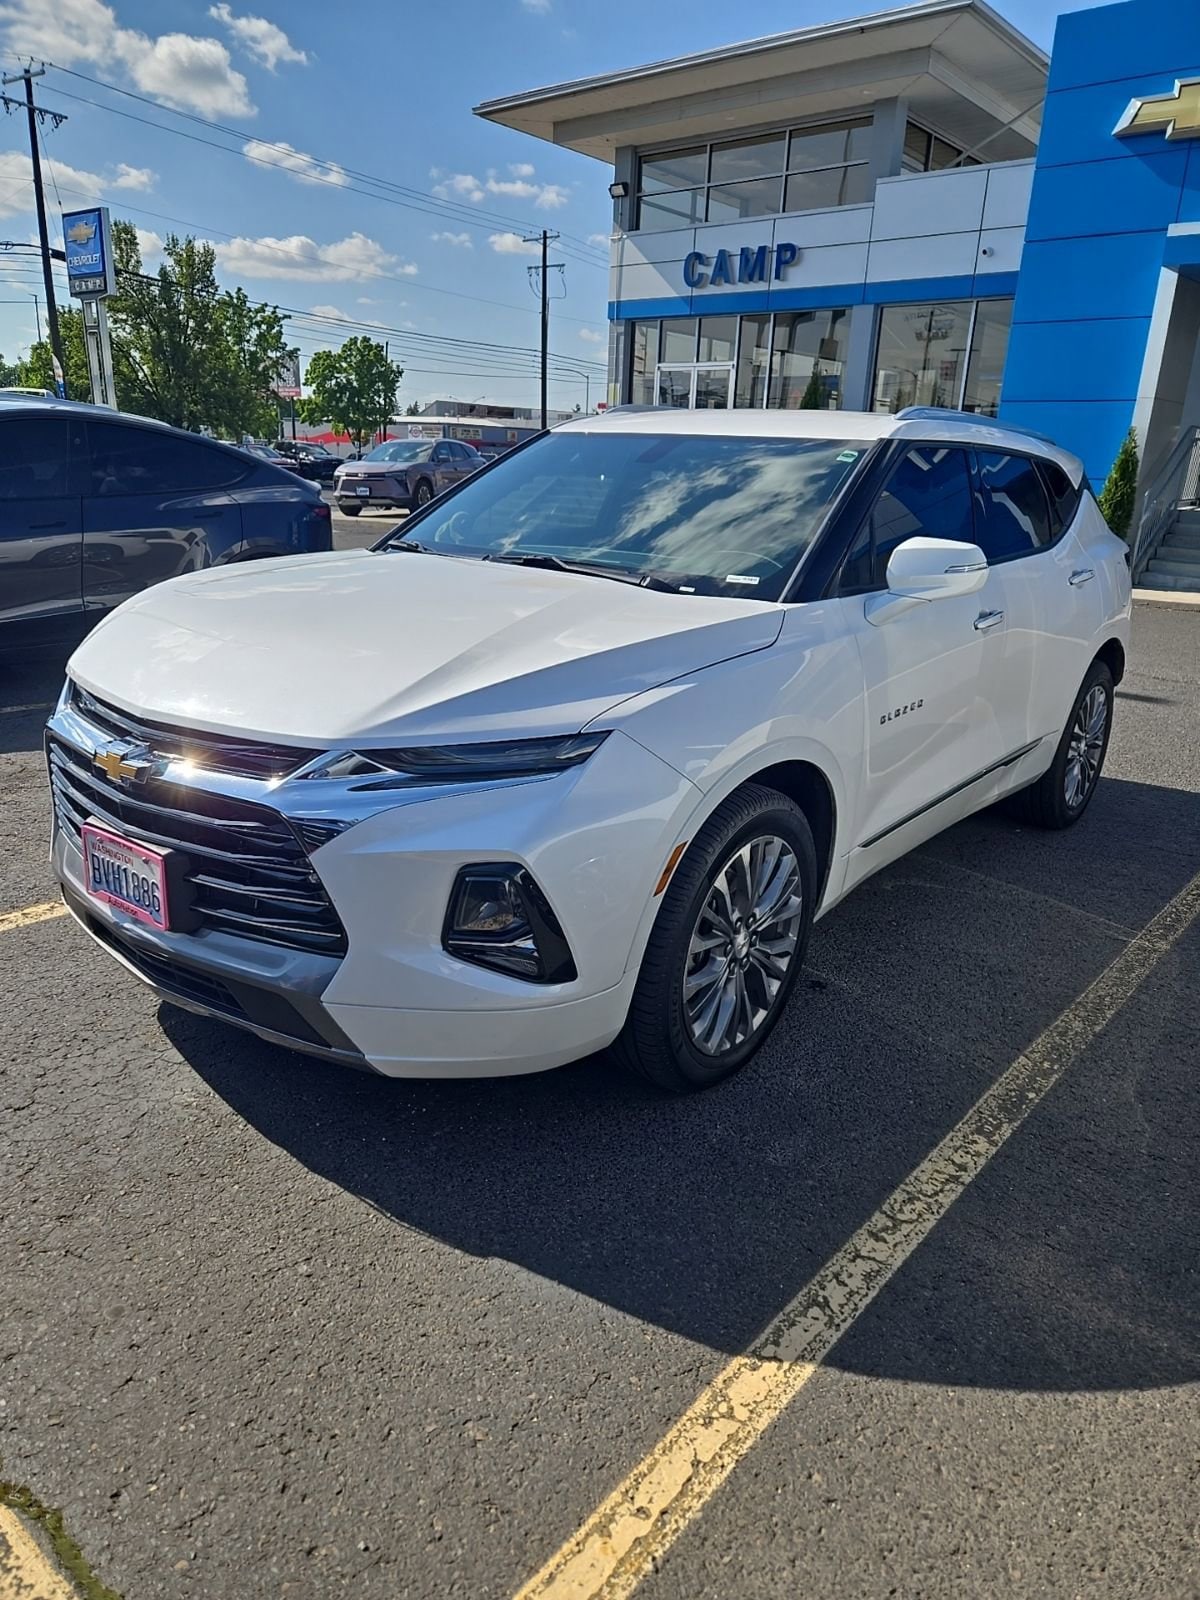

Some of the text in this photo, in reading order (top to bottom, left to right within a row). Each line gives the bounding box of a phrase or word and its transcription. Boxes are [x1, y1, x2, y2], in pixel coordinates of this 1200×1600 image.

[68, 253, 101, 267] CHEVROLET
[683, 243, 799, 288] CAMP
[74, 279, 101, 291] CAMP
[880, 698, 924, 725] BLAZER
[92, 840, 134, 867] WASHINGTON
[91, 852, 161, 913] BVH1886
